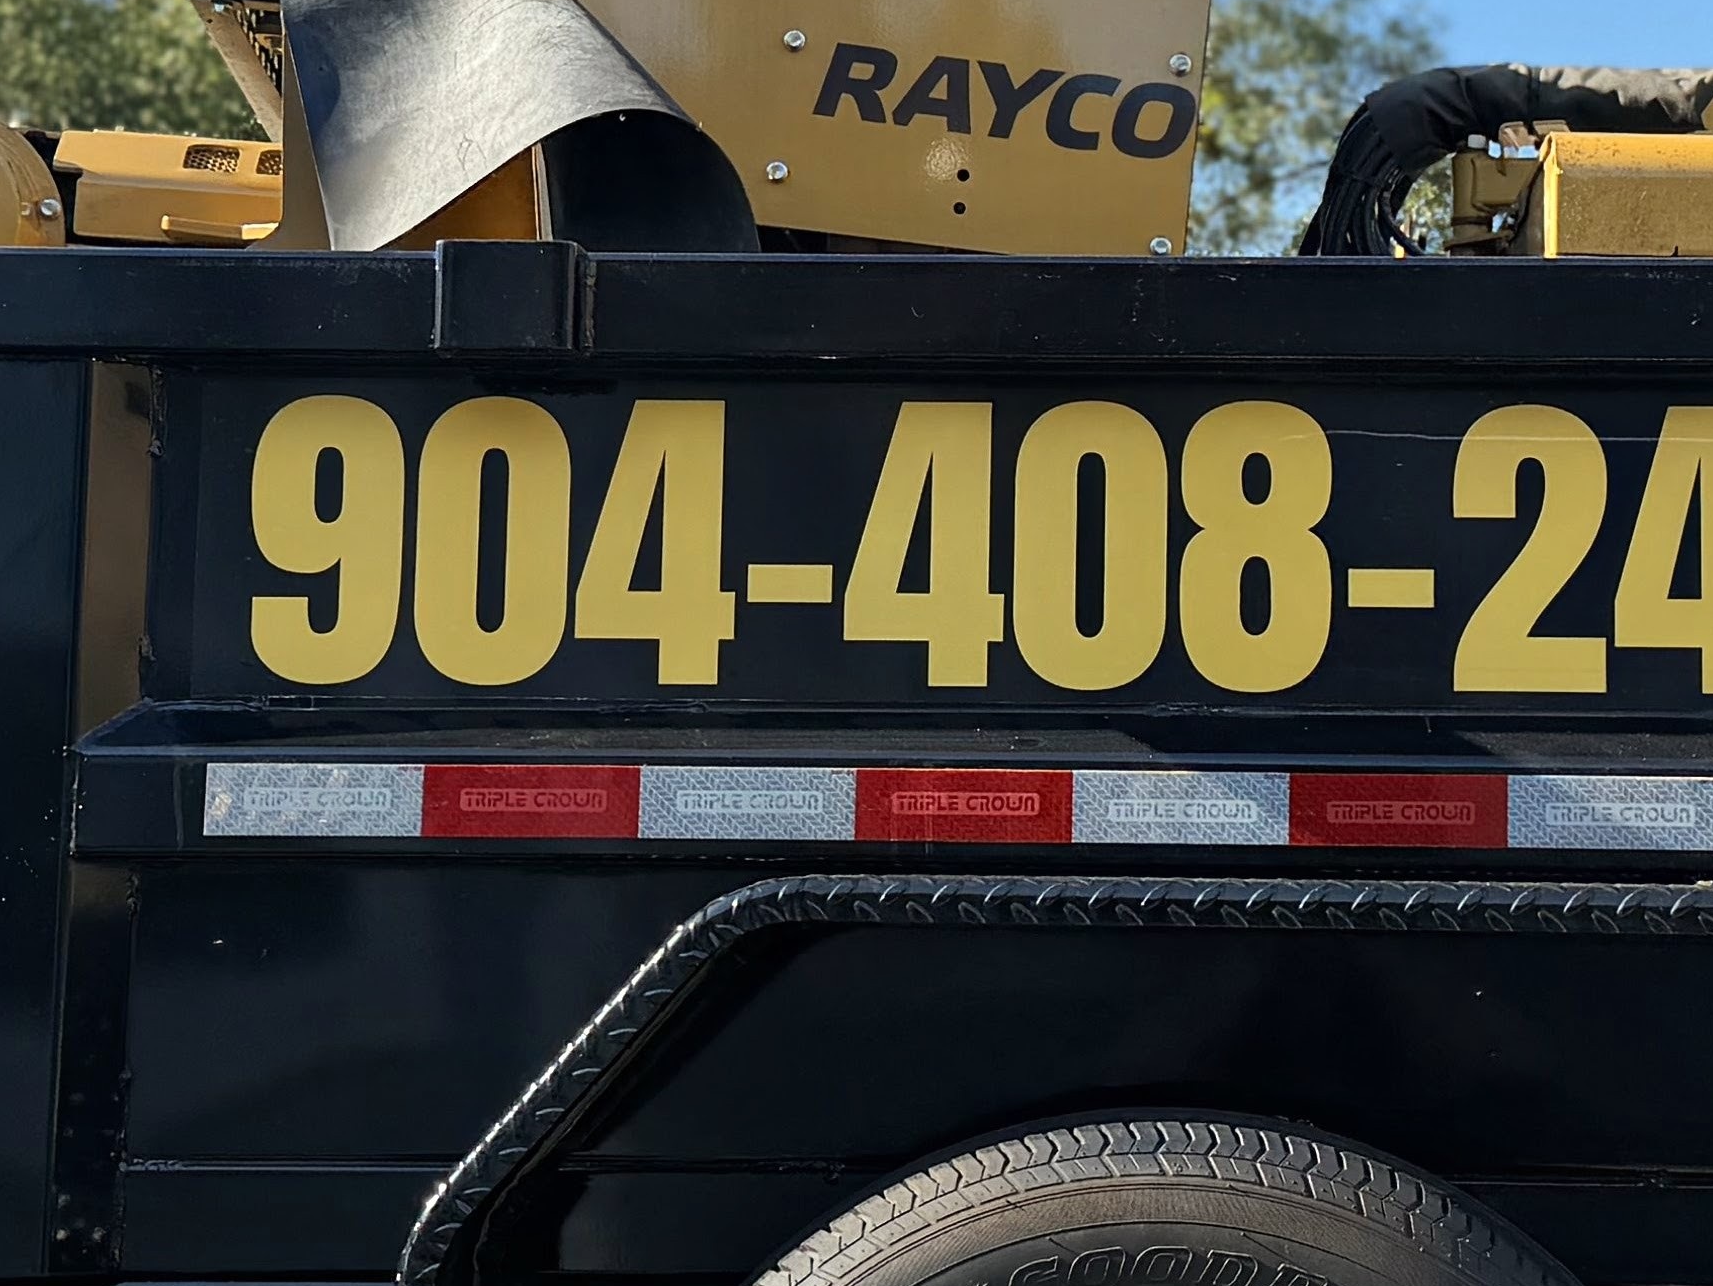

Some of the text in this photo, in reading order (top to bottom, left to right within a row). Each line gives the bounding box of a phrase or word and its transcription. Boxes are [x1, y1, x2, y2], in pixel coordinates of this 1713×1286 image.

[812, 42, 1198, 161] RAYCO
[465, 791, 602, 809] TRIPLE CROWN
[897, 795, 1036, 812] TRIPLE CROWN
[1114, 802, 1251, 819] TRIPLE CROWN
[1332, 803, 1471, 821] TRIPLE CROWN
